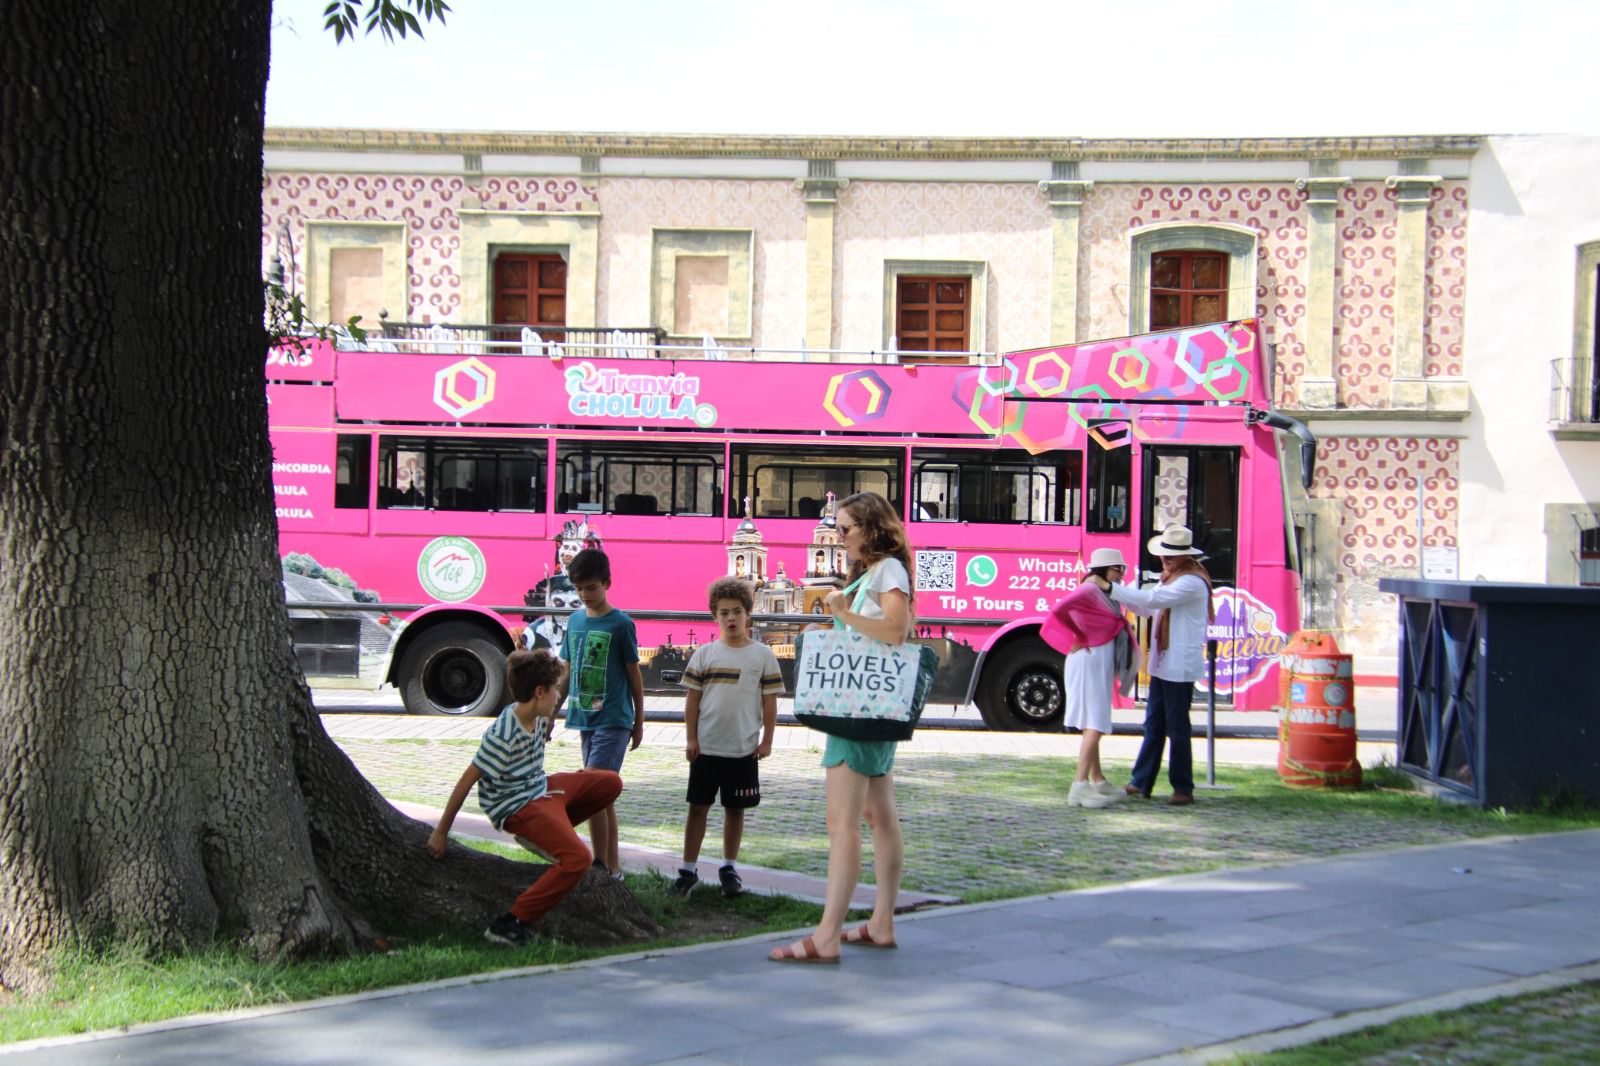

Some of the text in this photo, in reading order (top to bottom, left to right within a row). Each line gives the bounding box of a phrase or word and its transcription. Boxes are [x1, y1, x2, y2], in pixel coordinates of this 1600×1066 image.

[599, 369, 699, 395] Tranvía
[569, 393, 696, 419] CHOLULA
[275, 507, 314, 519] OLULA
[1018, 557, 1091, 573] WhatsA
[1009, 576, 1077, 591] 222 445
[939, 595, 1049, 612] Tip Tours &
[815, 652, 907, 676] LOVELY
[806, 671, 897, 693] THINGS
